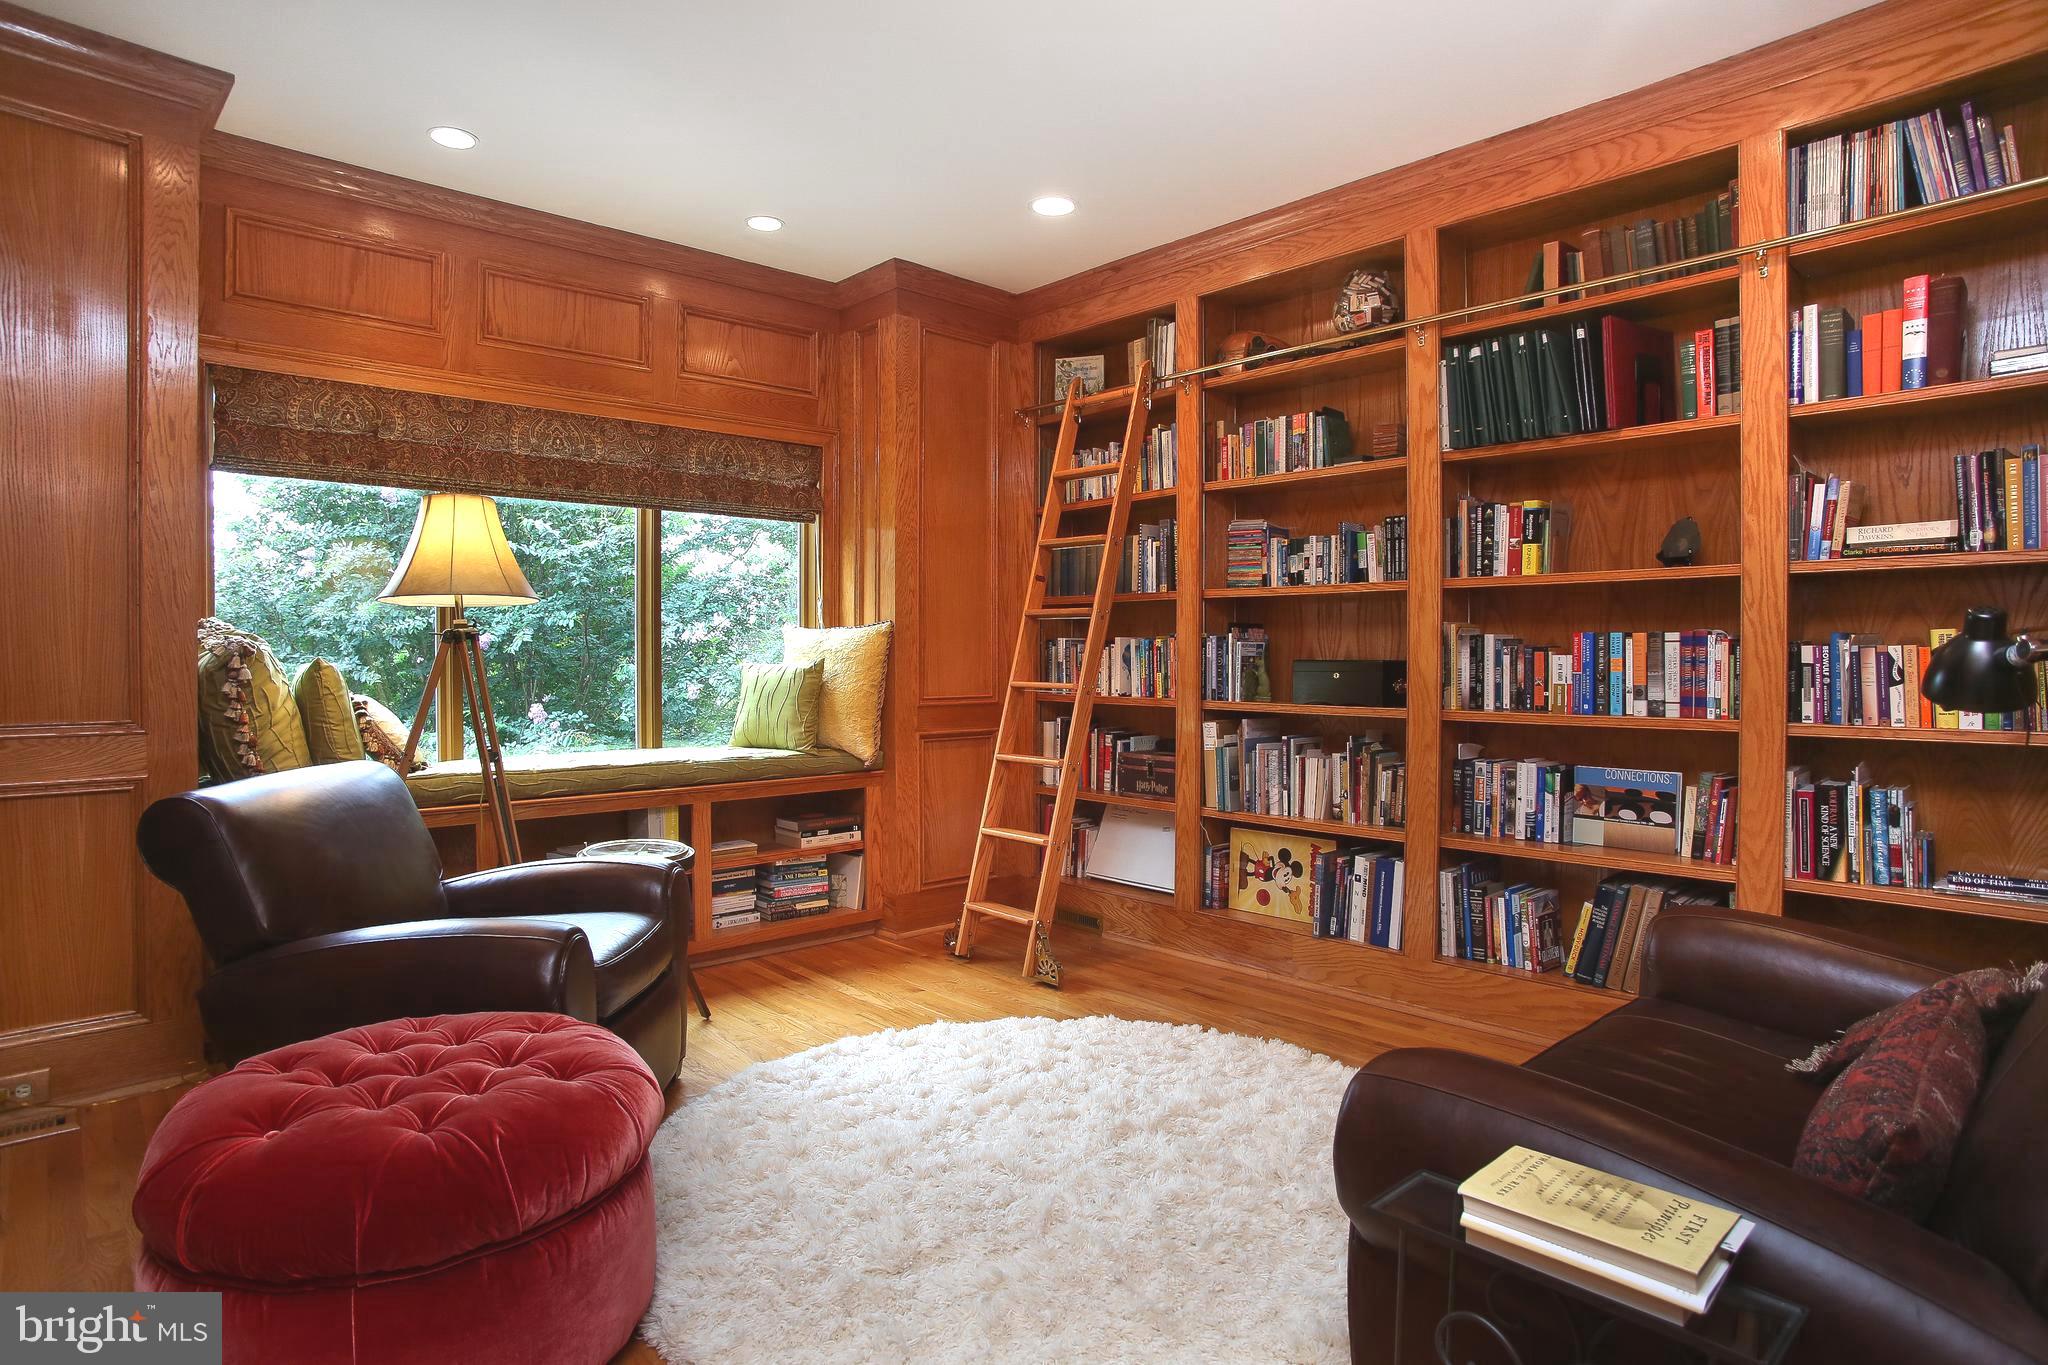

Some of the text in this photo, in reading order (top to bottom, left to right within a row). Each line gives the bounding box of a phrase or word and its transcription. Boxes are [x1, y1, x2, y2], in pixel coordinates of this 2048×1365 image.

[1604, 769, 1672, 785] CONNECTIONS:
[1829, 790, 1837, 824] WOLFRAM
[1821, 805, 1830, 866] KIND OF SCIENCE
[1830, 832, 1838, 849] NEW
[1989, 879, 2013, 887] TIME
[1521, 1154, 1552, 1175] THOMAS
[1494, 1180, 1520, 1196] RICKS
[1632, 1197, 1692, 1245] Principles
[1671, 1214, 1709, 1245] FIRST
